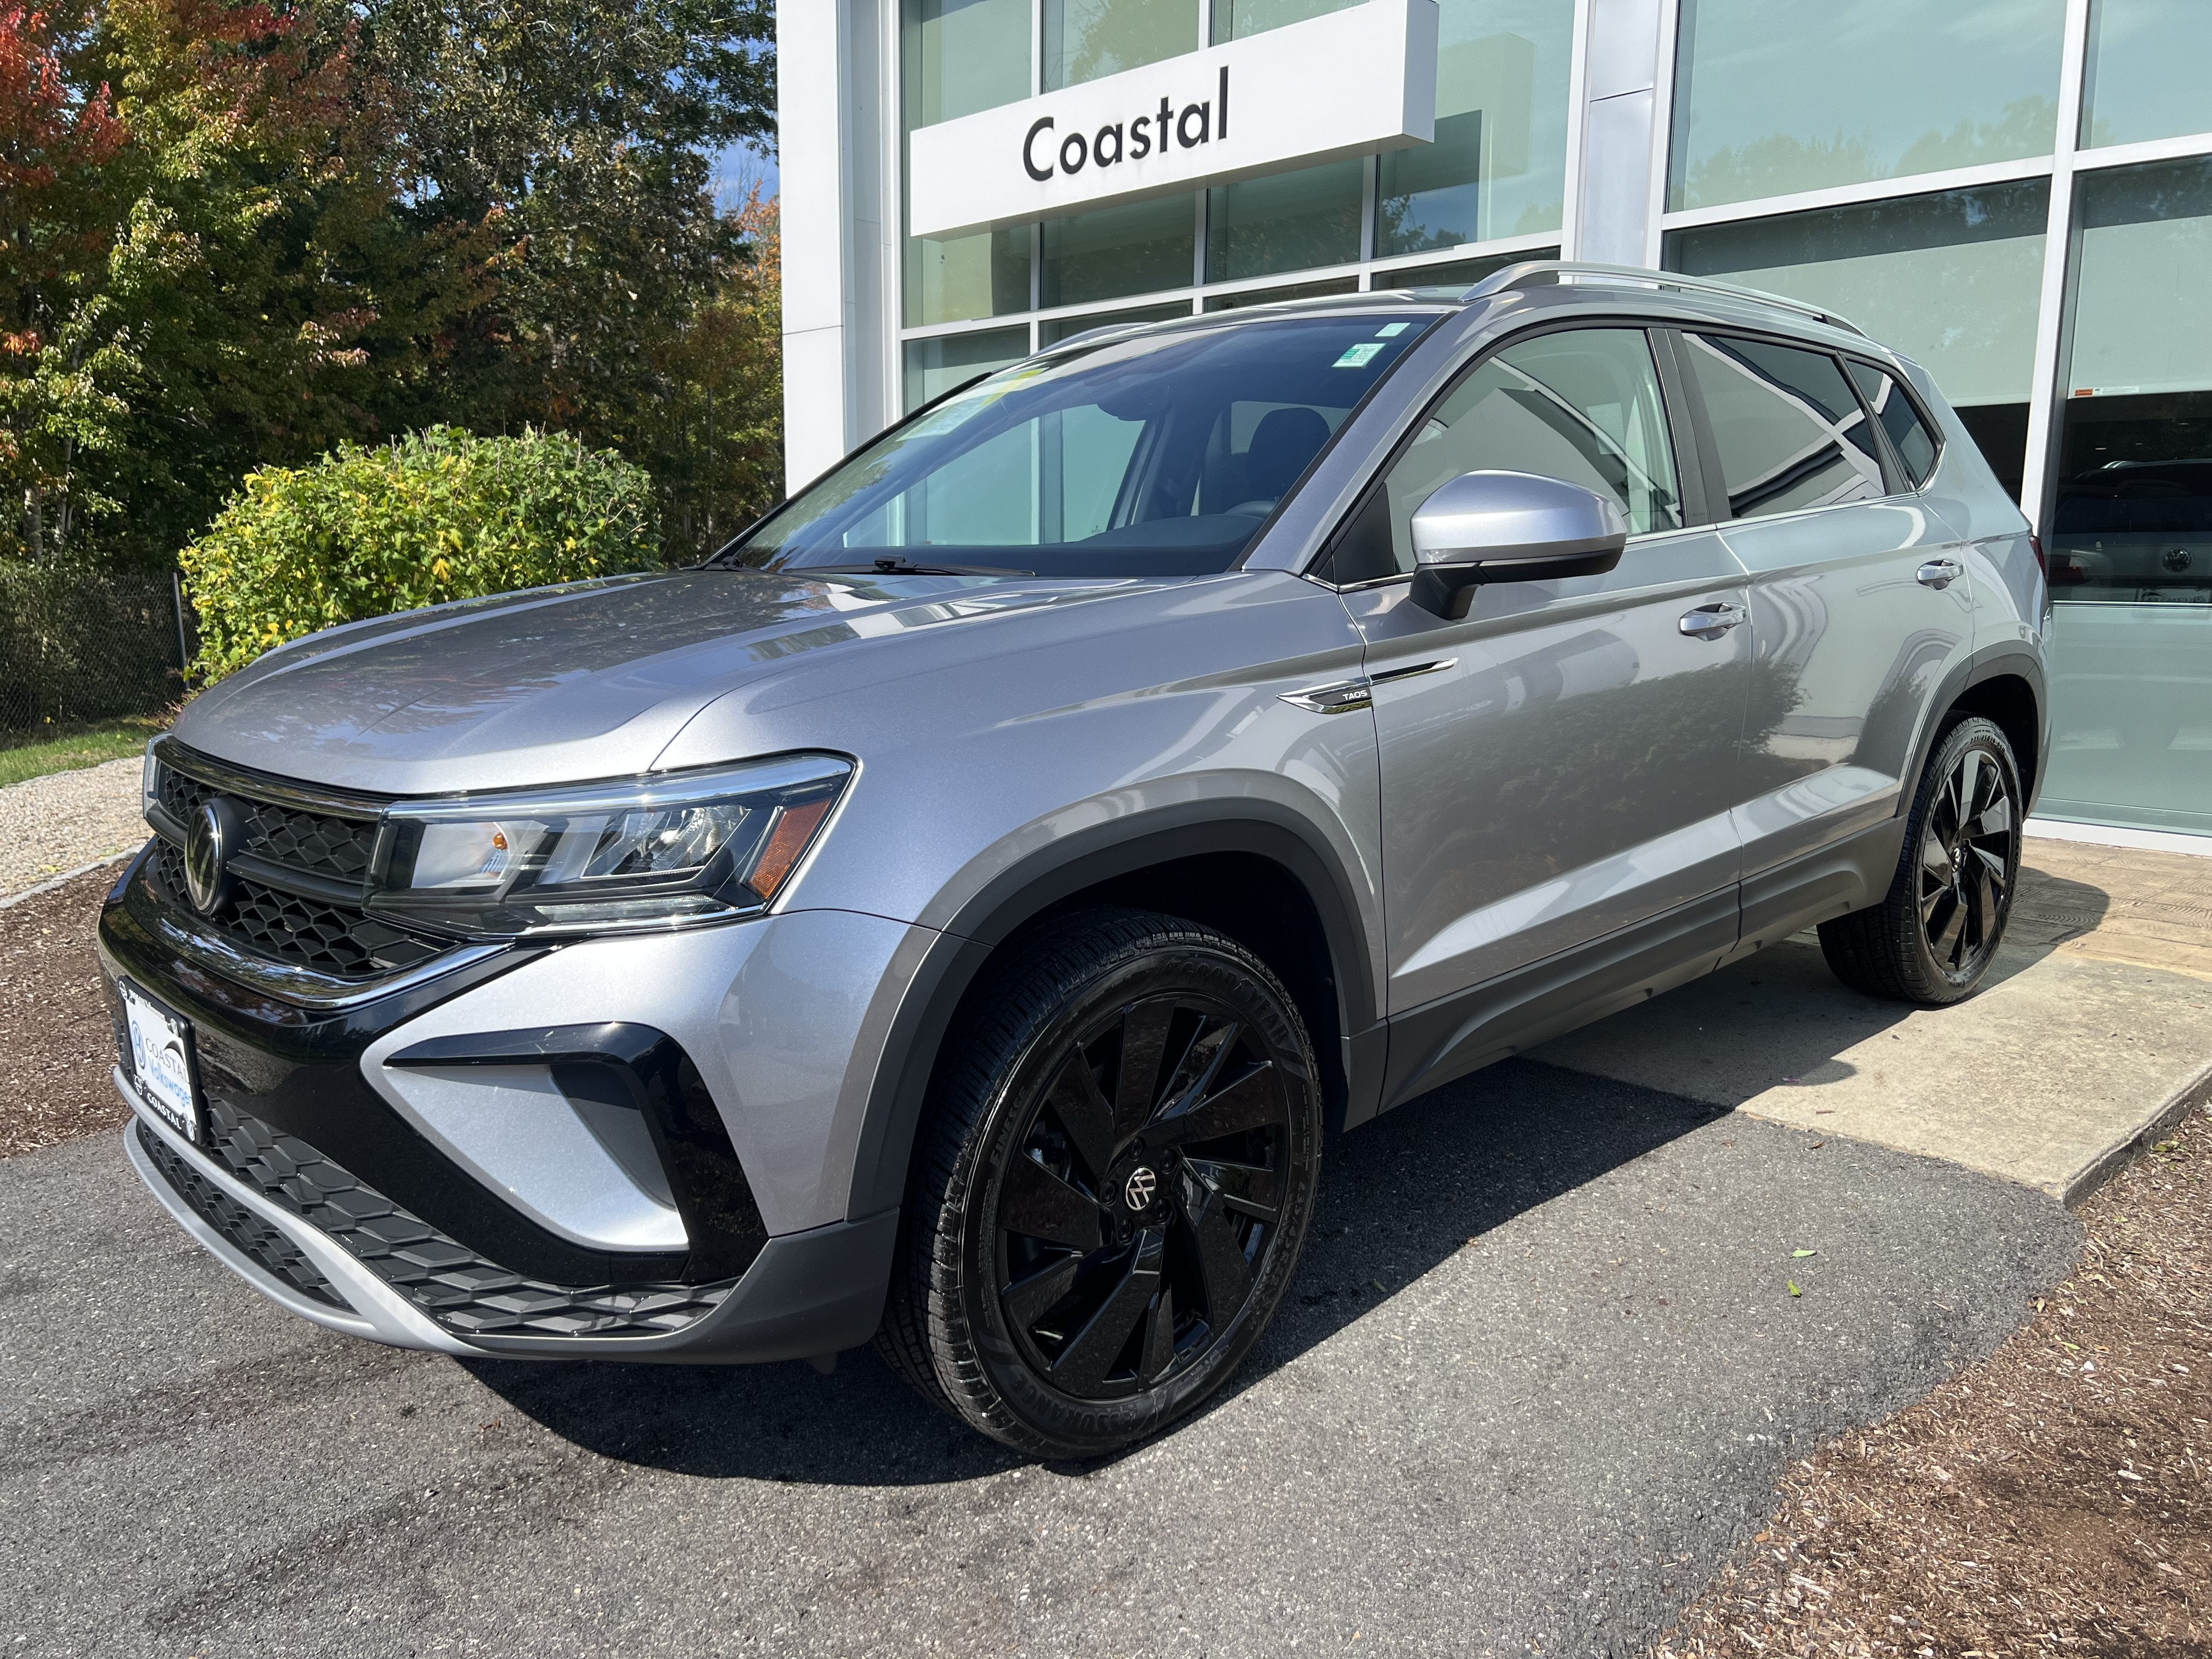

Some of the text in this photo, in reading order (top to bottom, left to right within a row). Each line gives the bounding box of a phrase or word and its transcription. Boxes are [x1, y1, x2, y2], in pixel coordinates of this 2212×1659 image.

[1023, 65, 1229, 182] Coastal
[1342, 690, 1368, 701] TAOS
[145, 1038, 190, 1084] COASTAL
[146, 1092, 182, 1130] COASTAL
[989, 1085, 1028, 1167] FINESSE
